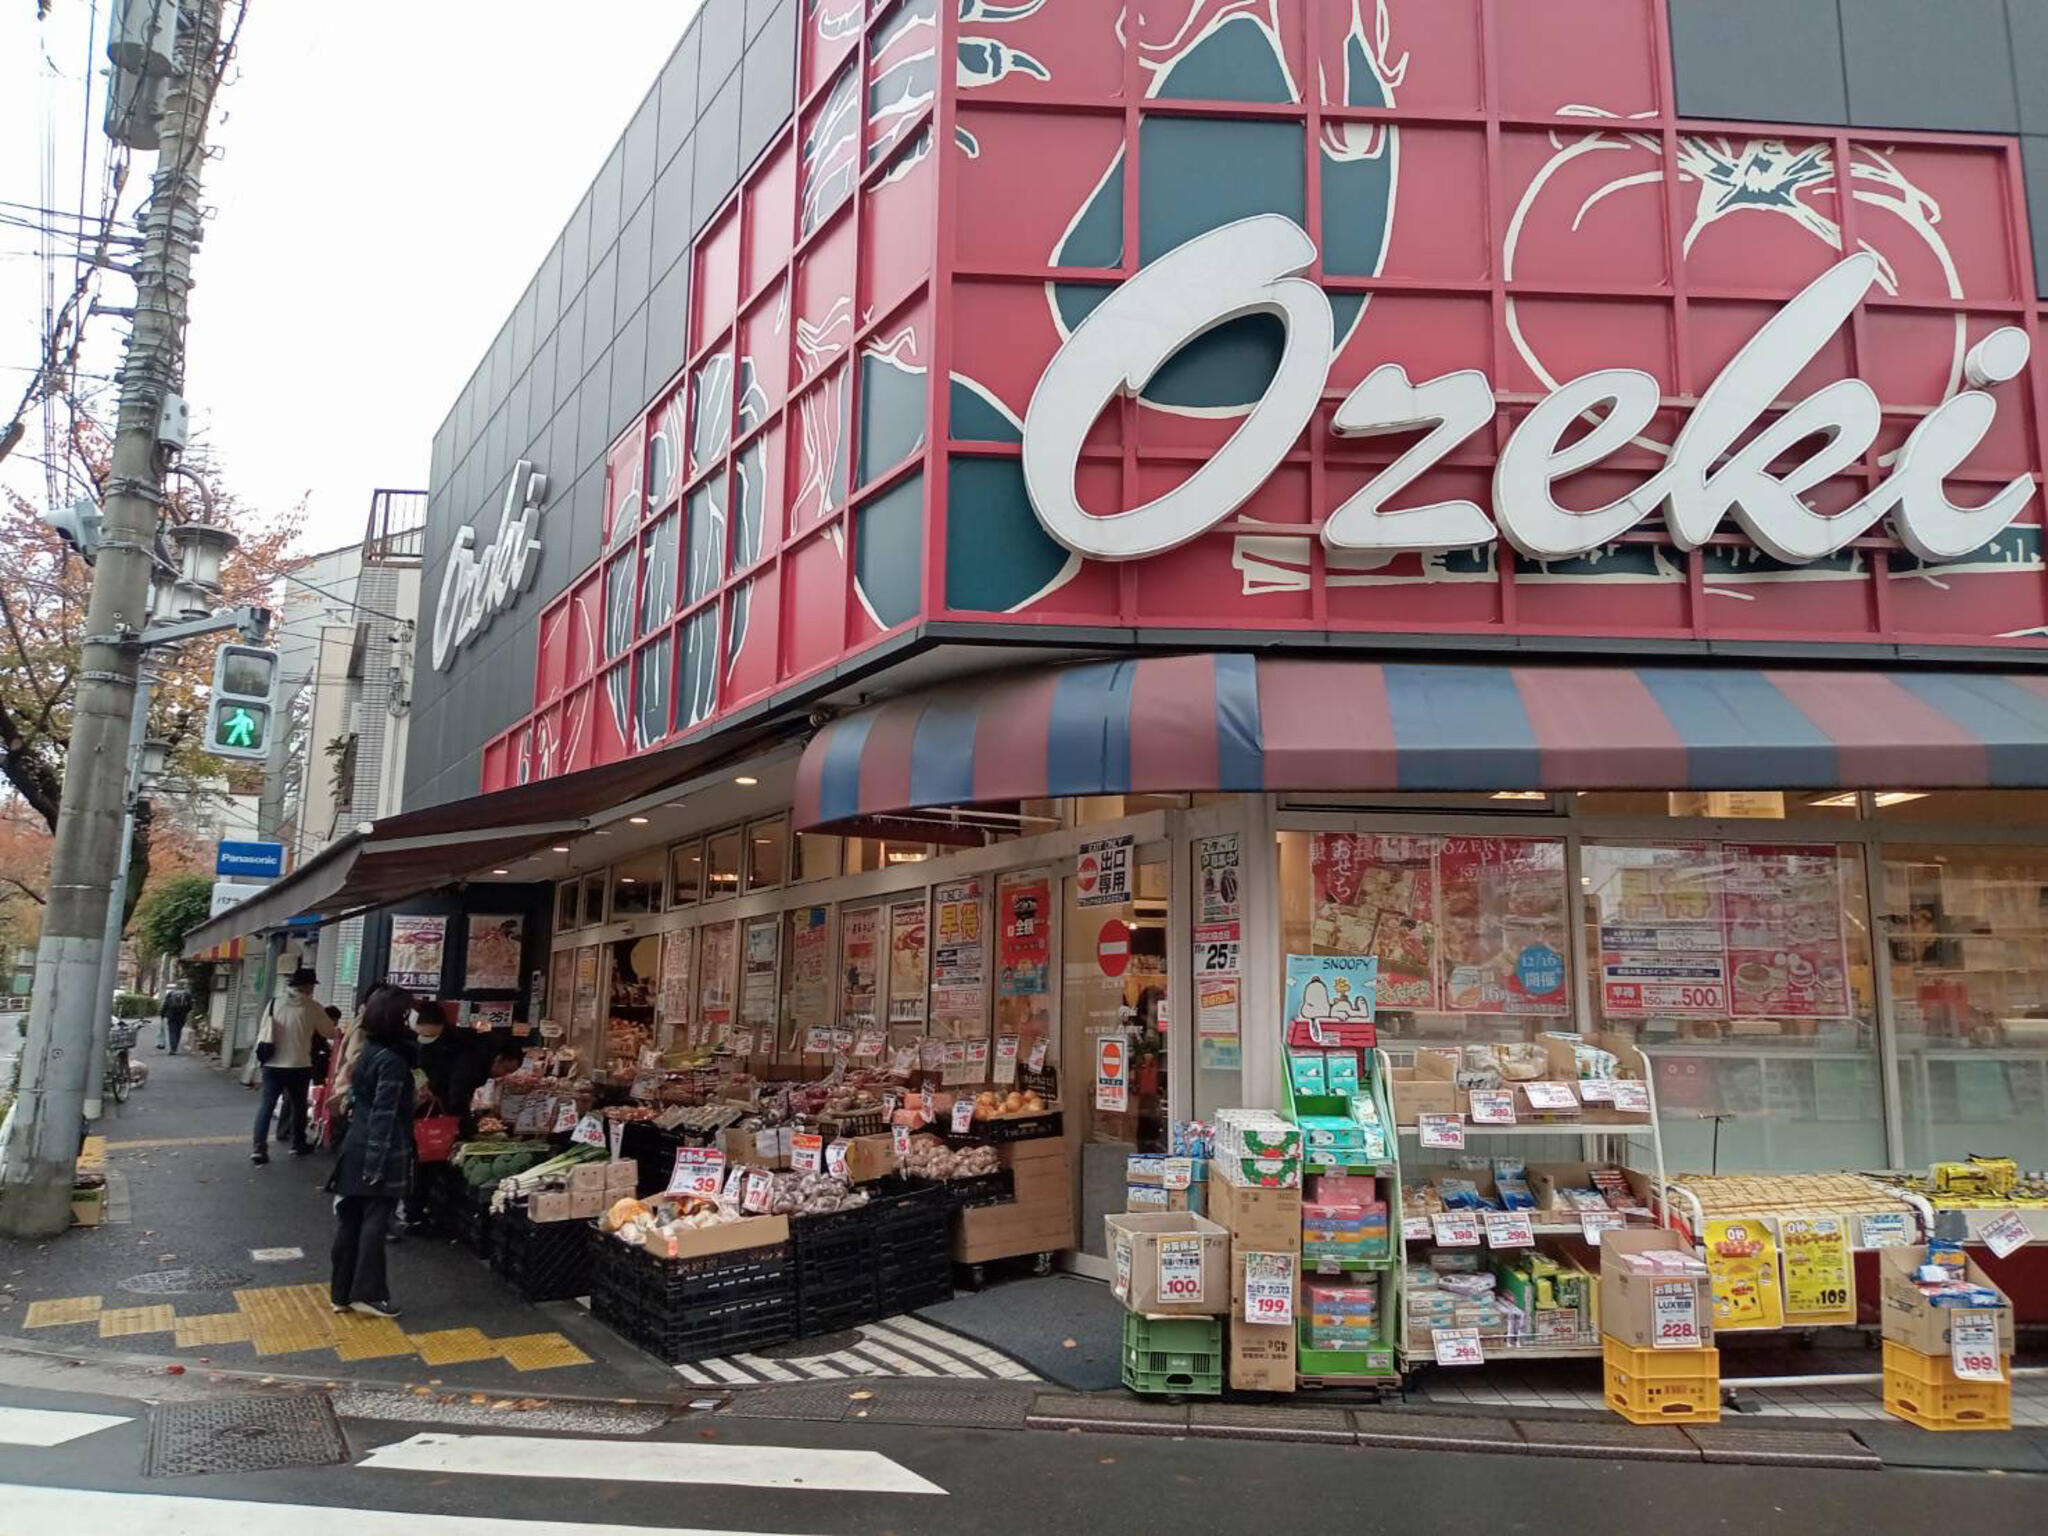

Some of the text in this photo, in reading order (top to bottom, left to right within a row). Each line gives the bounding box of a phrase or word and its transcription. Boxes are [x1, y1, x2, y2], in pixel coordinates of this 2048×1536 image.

[1022, 213, 2036, 562] Ozeki
[432, 459, 549, 673] Ozeki
[221, 853, 278, 864] Panasonic
[1100, 850, 1125, 871] 出口
[1206, 944, 1228, 970] 25
[1322, 959, 1371, 970] SNOOPY
[1682, 988, 1717, 1006] 500
[692, 1178, 716, 1192] 39
[1167, 1280, 1197, 1294] 100
[1257, 1298, 1285, 1313] 199
[1663, 1323, 1693, 1337] 228
[1962, 1356, 1993, 1370] 199
